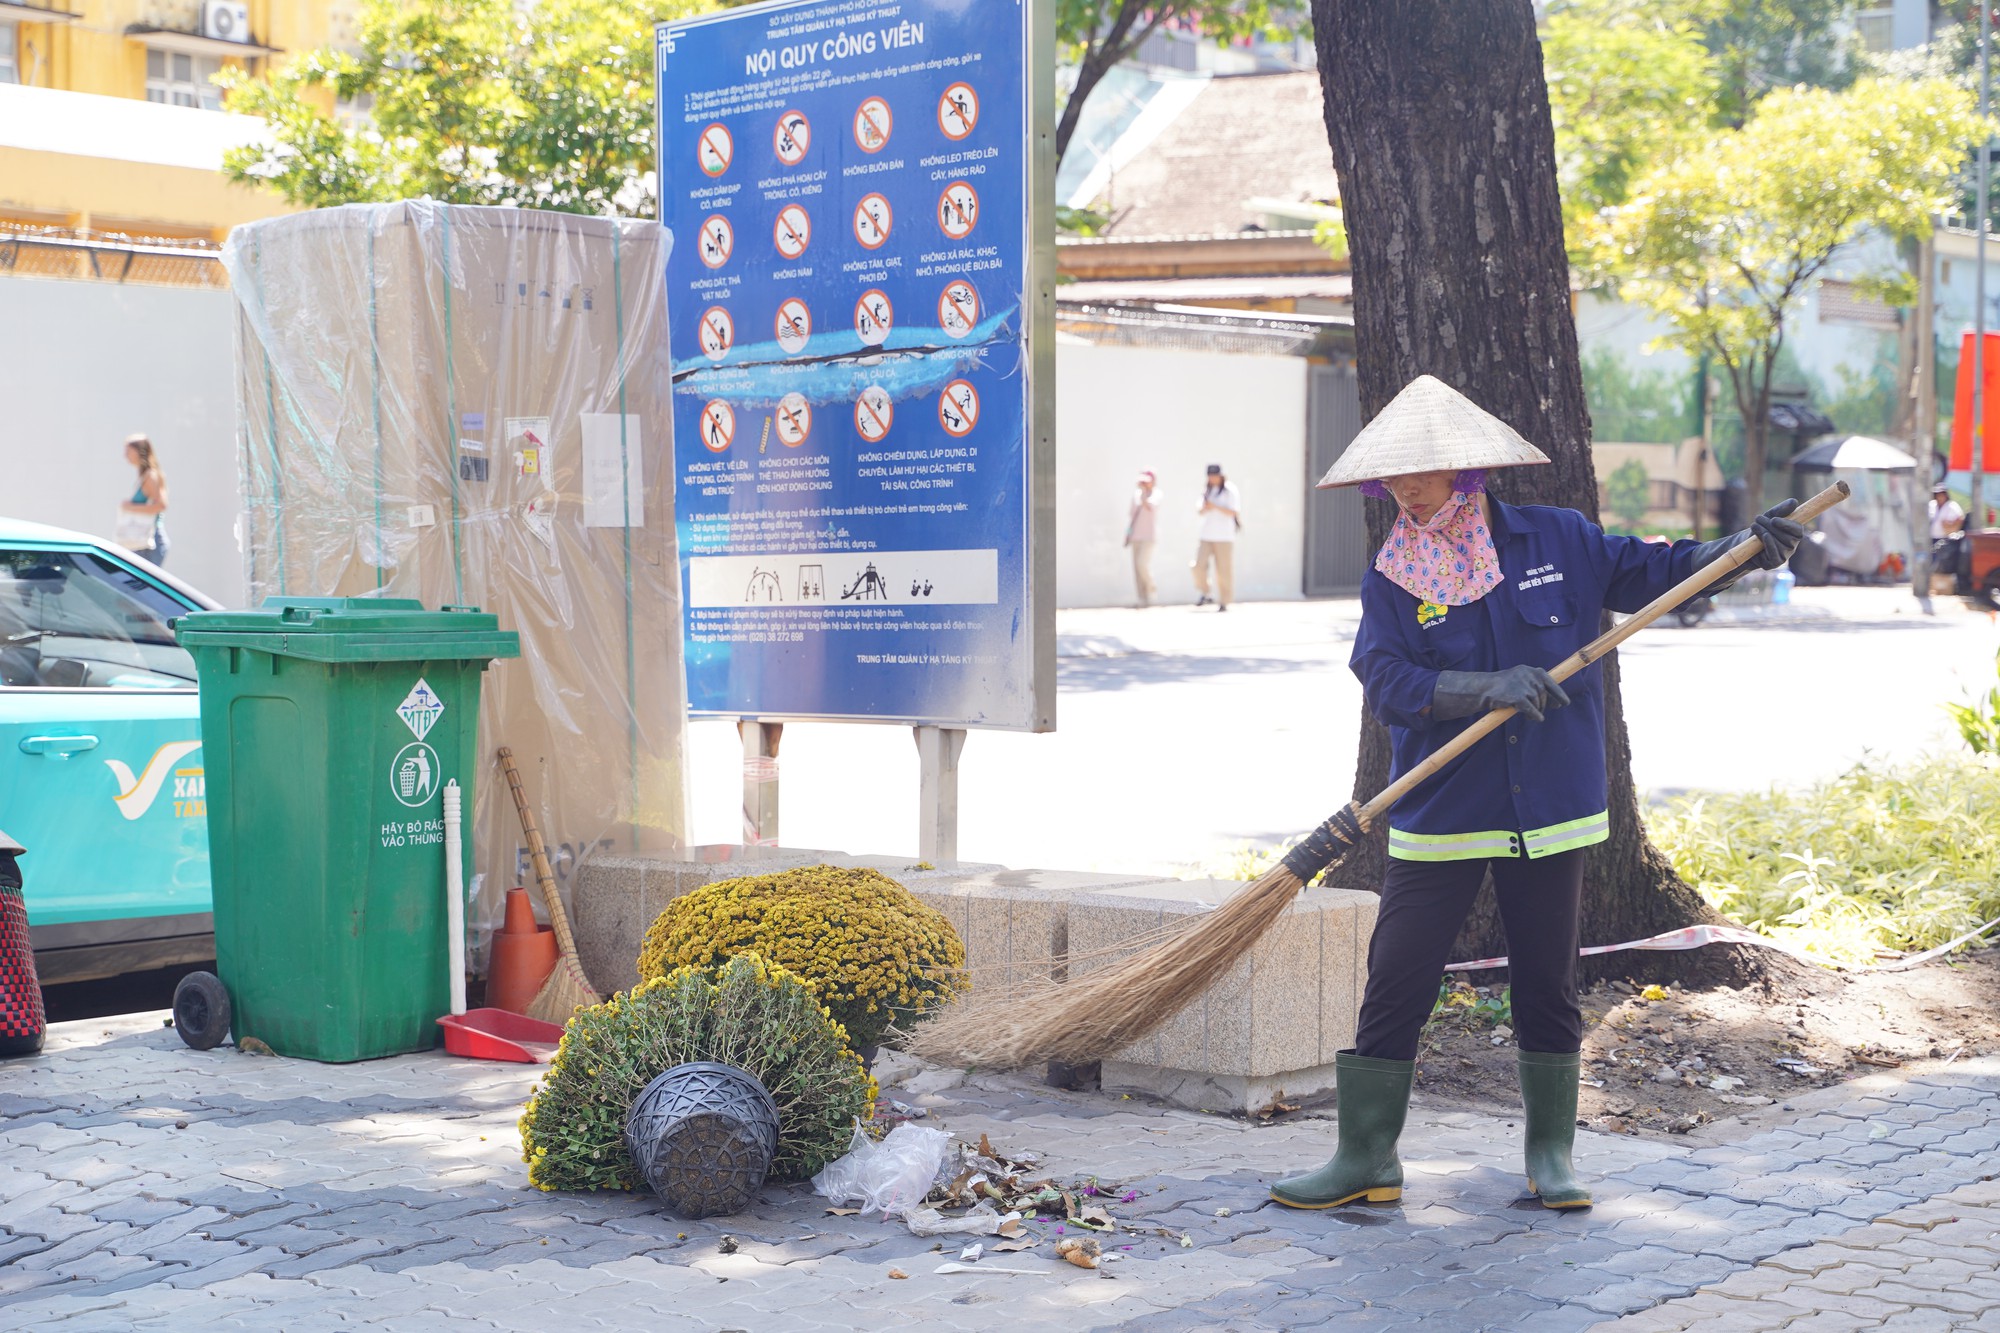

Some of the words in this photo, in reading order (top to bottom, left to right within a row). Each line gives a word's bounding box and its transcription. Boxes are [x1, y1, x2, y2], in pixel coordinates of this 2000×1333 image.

[746, 48, 776, 77] NỘI
[780, 42, 818, 69] QUY
[822, 32, 876, 61] CÔNG
[881, 20, 923, 49] VIÊN
[920, 155, 946, 166] KHÔNG
[947, 153, 962, 163] LEO
[921, 252, 946, 262] KHÔNG
[978, 346, 988, 357] XE
[858, 452, 882, 462] KHÔNG
[809, 481, 832, 490] CHUNG
[910, 479, 931, 489] CÔNG
[777, 631, 789, 641] 272
[857, 655, 880, 663] TRUNG
[882, 654, 896, 663] TÂM
[920, 654, 928, 663] LÝ
[930, 656, 940, 665] HẠ
[404, 710, 439, 735] MTĐT
[382, 822, 404, 835] HÃY
[407, 820, 421, 833] BỎ
[424, 818, 444, 832] RÁC
[382, 835, 405, 847] VÀO
[409, 832, 443, 845] THÙNG
